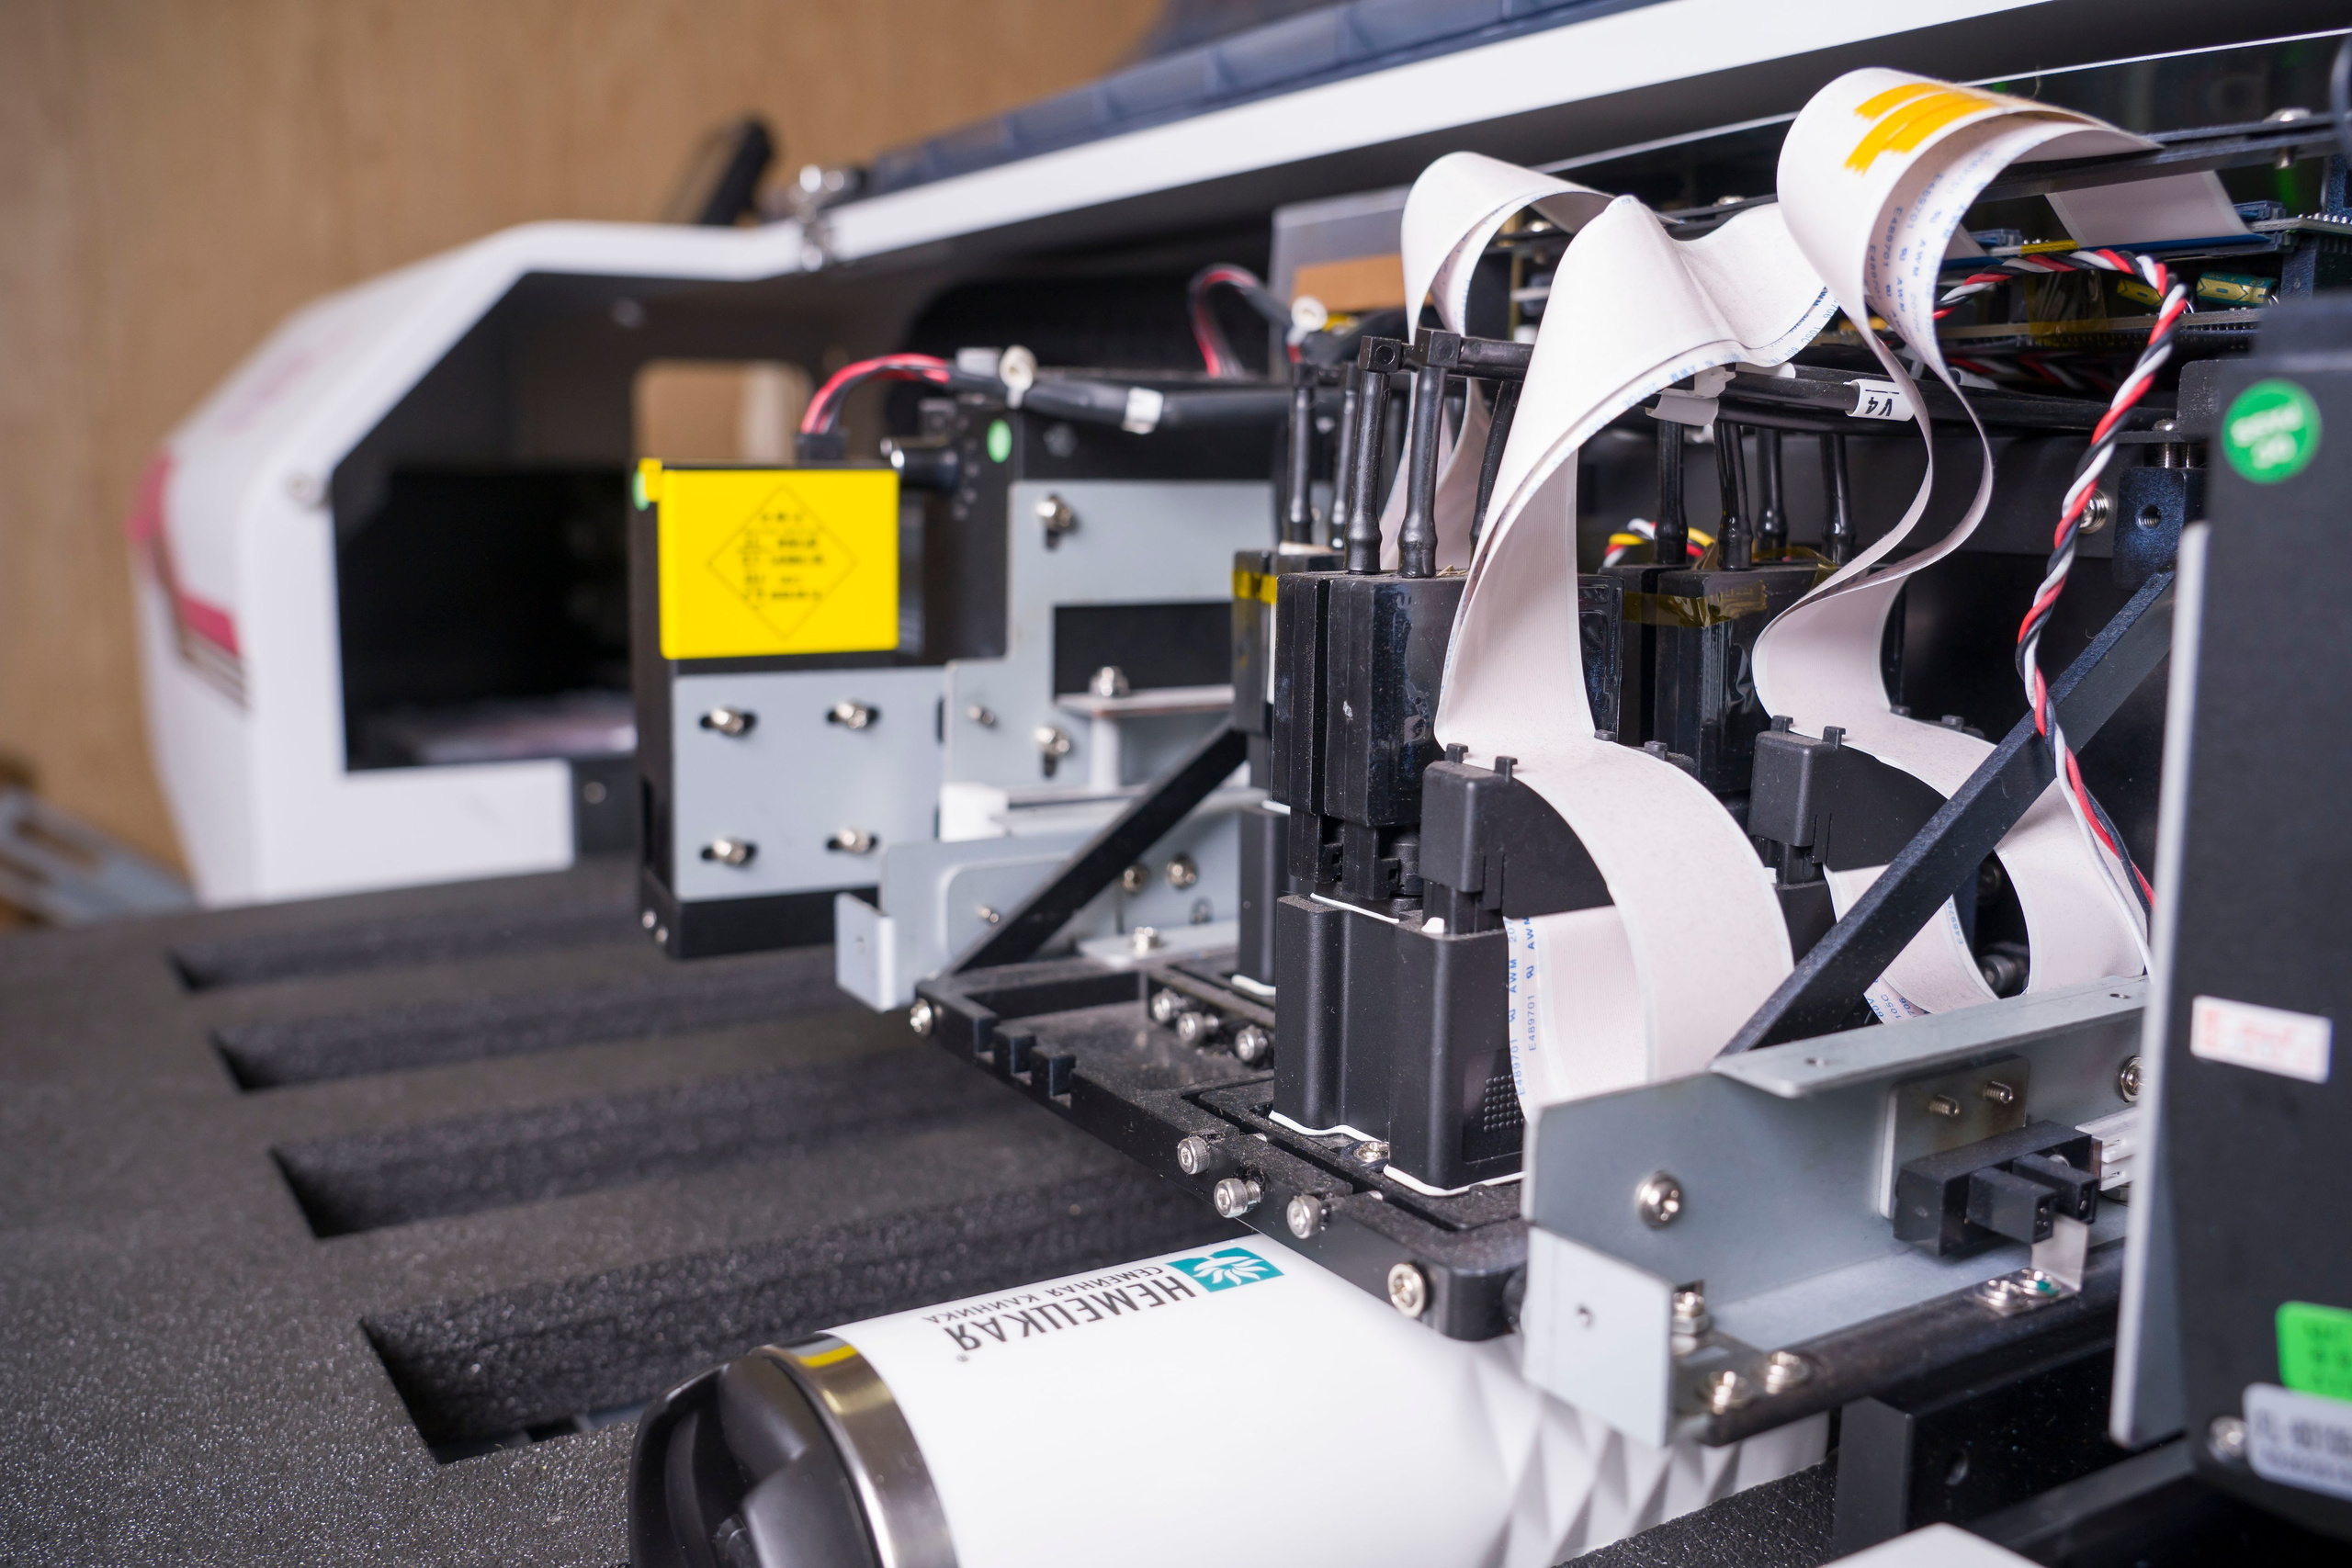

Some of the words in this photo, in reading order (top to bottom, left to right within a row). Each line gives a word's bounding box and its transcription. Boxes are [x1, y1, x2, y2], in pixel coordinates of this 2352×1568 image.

[1882, 205, 1903, 267] E489701
[1896, 276, 1905, 312] AWM
[1801, 326, 1821, 344] 105C
[1865, 396, 1893, 417] V4
[1509, 959, 1517, 993] AWM
[1866, 998, 1884, 1018] 60V
[1881, 994, 1902, 1019] 105C
[1527, 995, 1537, 1052] E489701
[1510, 1038, 1526, 1096] E489701
[1047, 1266, 1163, 1297] СЕМЕЙНАЯ
[922, 1293, 1041, 1324] КЛИНИКА
[944, 1276, 1196, 1351] НЕМЕЦКАЯ
